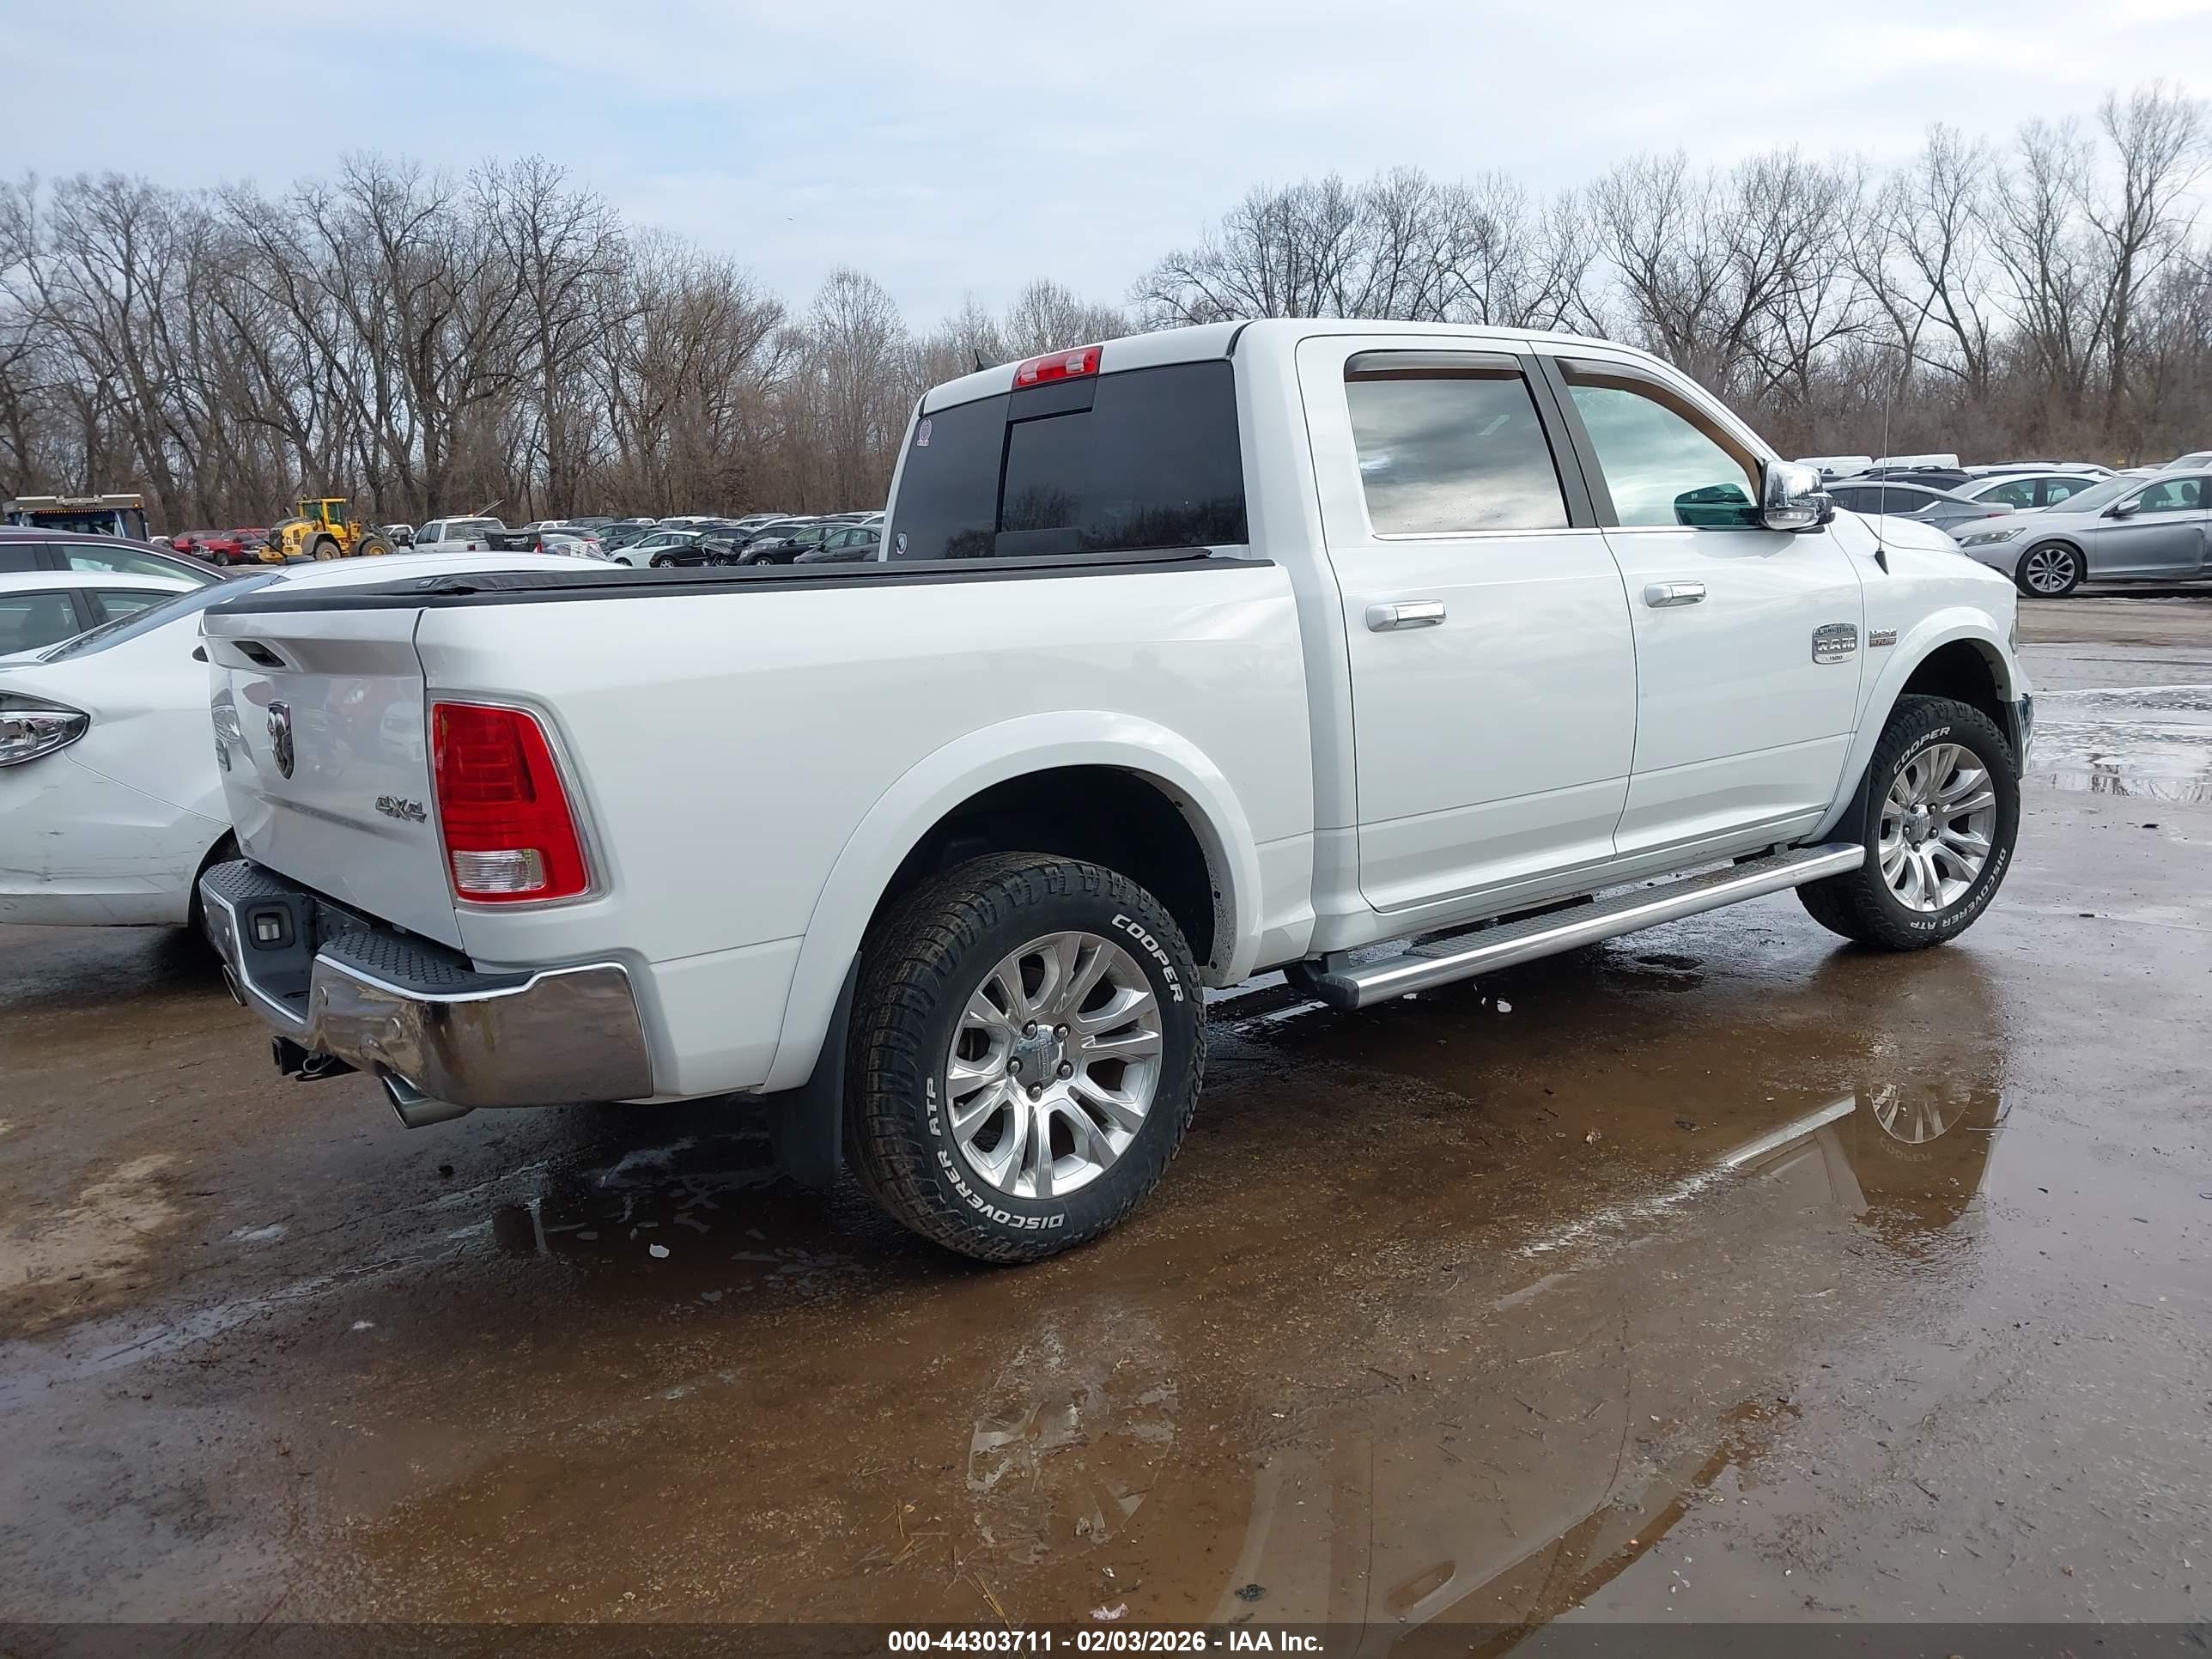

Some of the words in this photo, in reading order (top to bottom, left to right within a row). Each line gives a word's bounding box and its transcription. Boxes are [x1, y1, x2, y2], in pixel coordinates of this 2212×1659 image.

[1817, 637, 1856, 652] RAM
[1893, 726, 1951, 775] COOPER
[1942, 848, 2007, 927] DISCOVERER
[1910, 921, 1936, 930] ATP
[1111, 914, 1184, 1003] COOPER
[926, 1077, 943, 1137] ATP
[937, 1149, 1065, 1230] DISCOVERER
